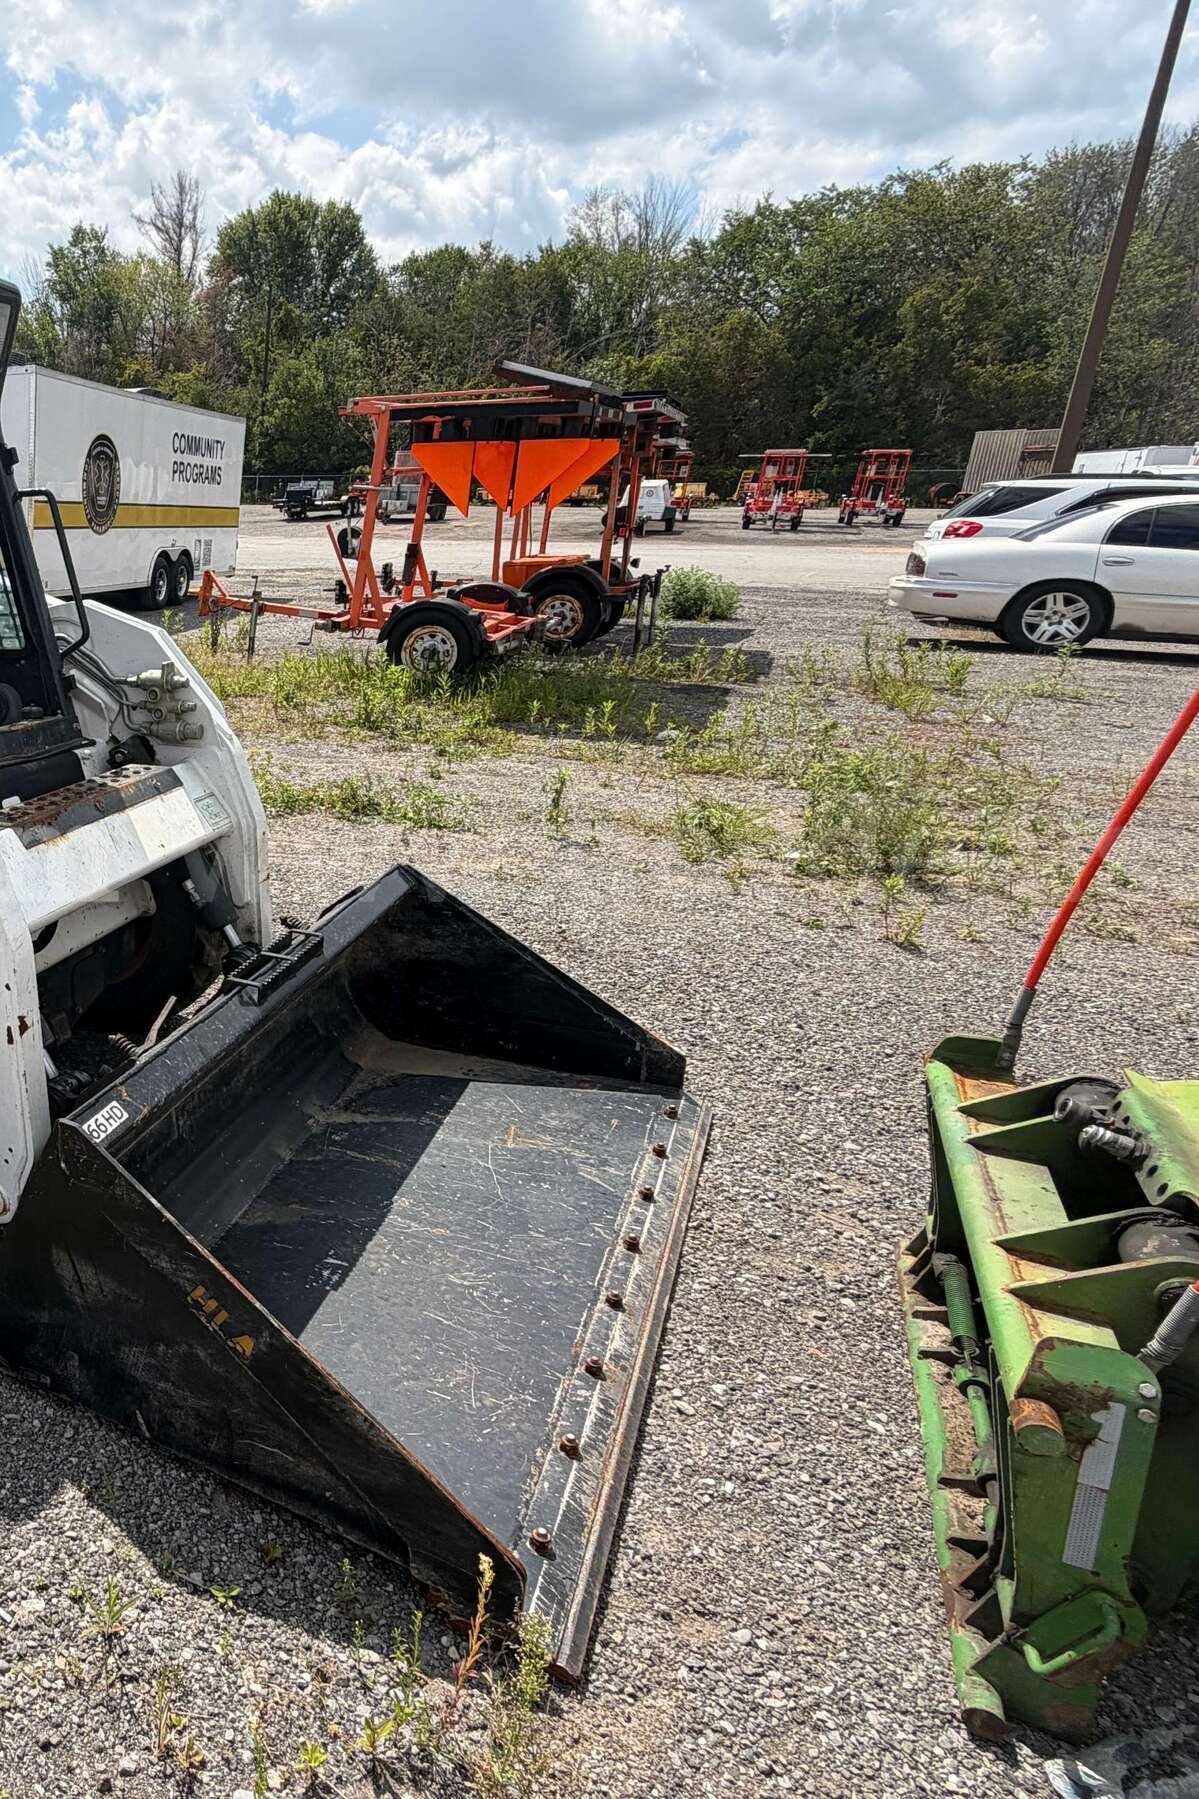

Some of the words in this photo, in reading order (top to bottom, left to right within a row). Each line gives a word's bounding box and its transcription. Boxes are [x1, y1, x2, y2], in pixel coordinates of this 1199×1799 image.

[172, 432, 226, 460] COMMUNITY
[171, 460, 222, 486] PROGRAMS
[86, 1105, 125, 1140] 66HD
